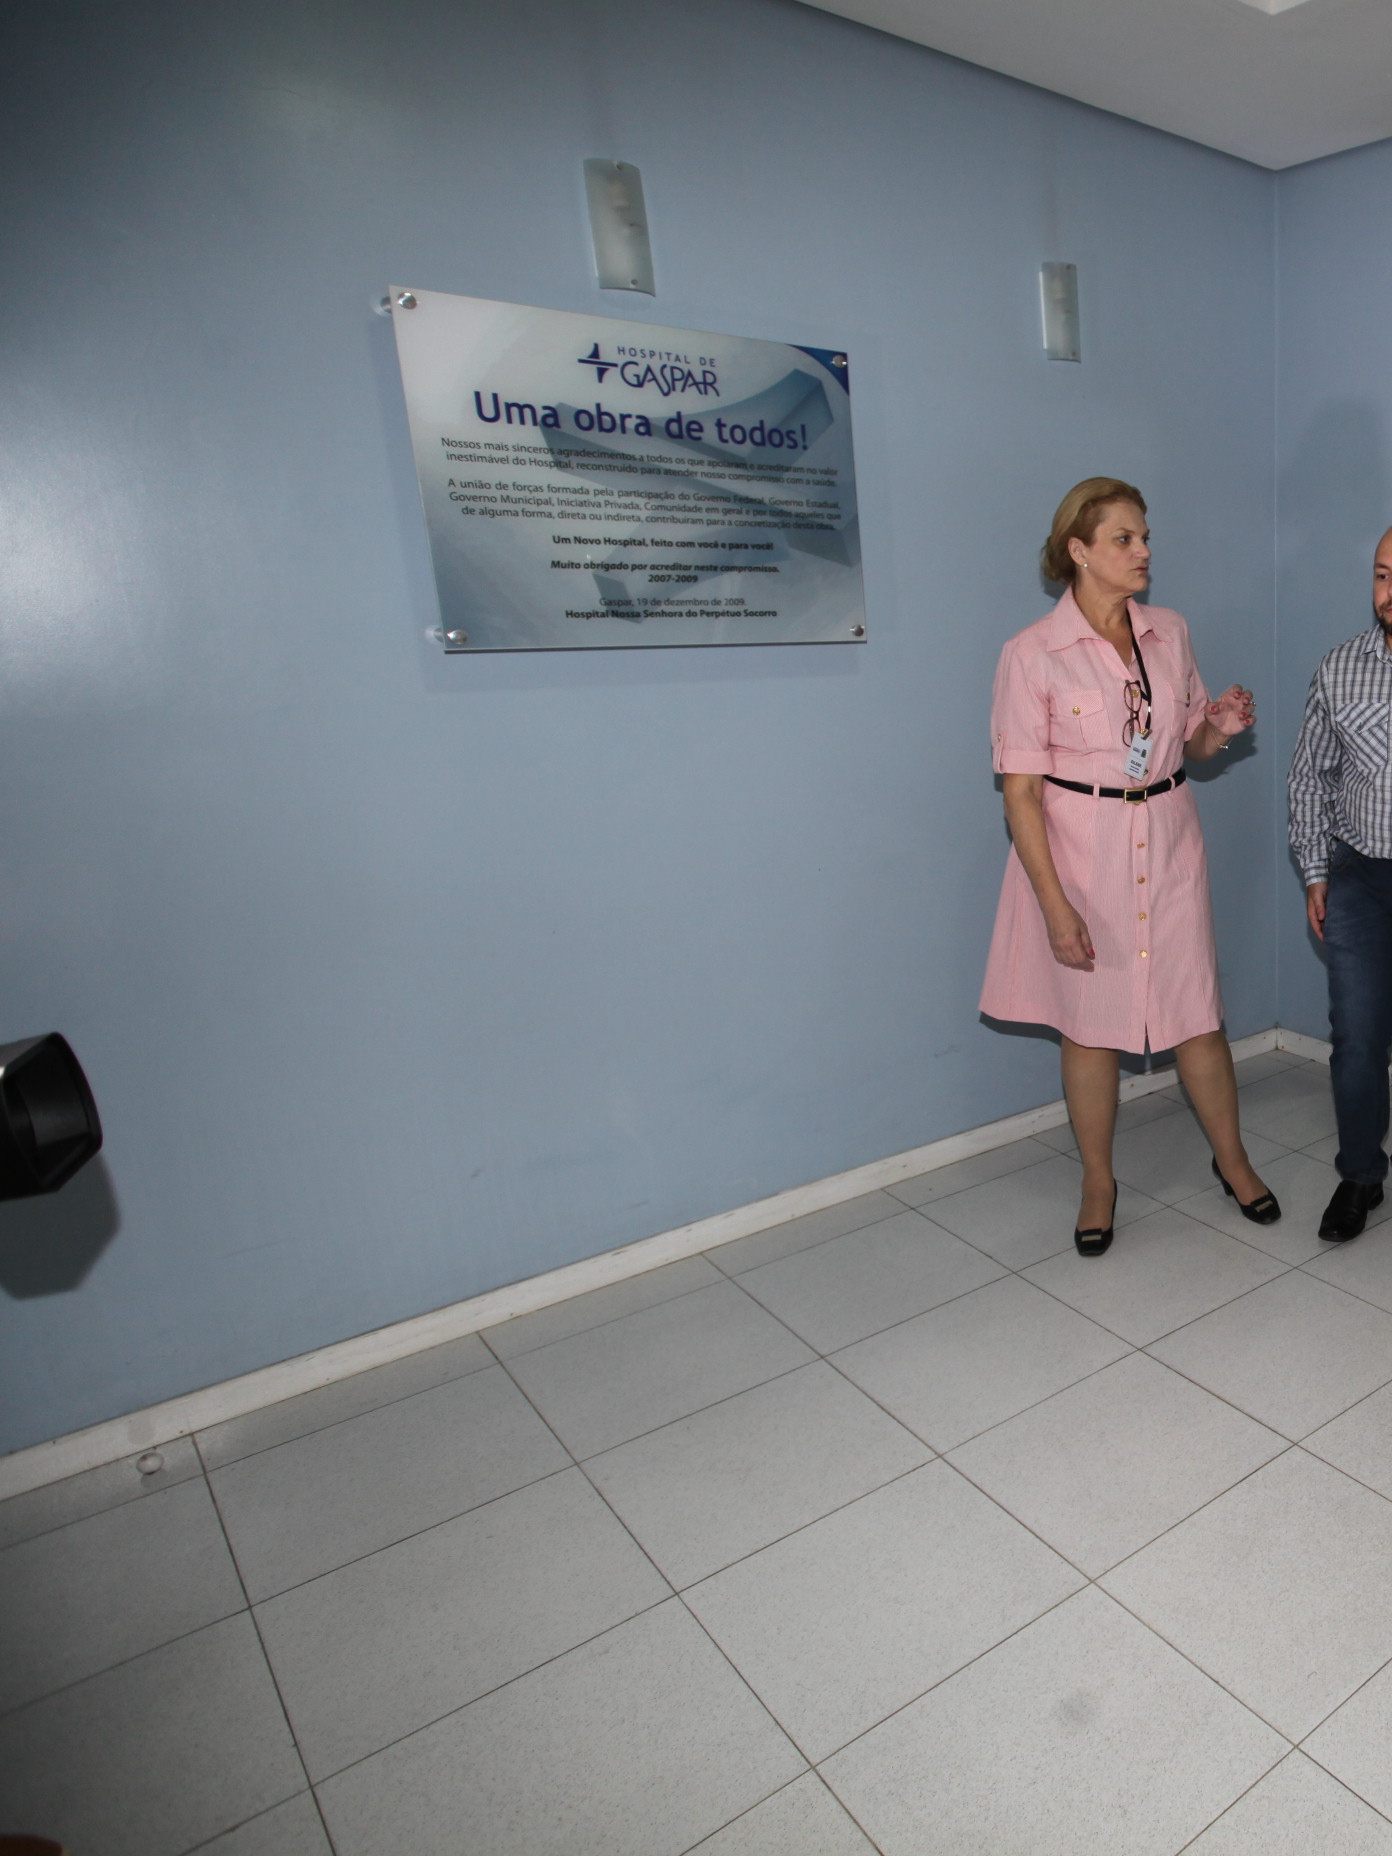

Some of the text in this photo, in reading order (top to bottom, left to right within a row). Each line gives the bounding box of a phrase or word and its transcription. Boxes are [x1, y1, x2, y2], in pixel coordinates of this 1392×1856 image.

[617, 346, 716, 367] HOSPITAL DE
[619, 361, 720, 397] GASPAR
[474, 390, 808, 450] Uma obra de todos!
[441, 438, 481, 449] Nossos
[484, 442, 509, 451] mais
[512, 444, 554, 455] sinceros
[557, 448, 636, 461] agradecimentos
[646, 454, 673, 464] todos
[687, 458, 705, 467] que
[819, 467, 838, 475] valor
[446, 451, 509, 464] inestimável
[512, 456, 526, 466] do
[529, 457, 574, 470] Hospital,
[640, 466, 661, 475] para
[663, 467, 698, 477] atender
[700, 471, 726, 479] nosso
[728, 473, 785, 483] compromisso
[448, 479, 456, 488] A
[460, 480, 492, 490] união
[495, 481, 509, 490] de
[512, 482, 544, 493] forças
[547, 483, 590, 495] formada
[593, 488, 614, 497] pela
[617, 489, 675, 501] participação
[678, 492, 690, 500] do
[693, 493, 731, 503] Governo
[768, 497, 804, 507] Governo
[449, 491, 498, 503] Governo
[500, 495, 554, 507] Municipal,
[557, 498, 602, 509] Iniciativa
[604, 500, 642, 511] Privada,
[644, 502, 703, 514] Comunidade
[721, 507, 743, 516] geral
[753, 509, 767, 517] por
[794, 511, 825, 520] aqueles
[827, 513, 842, 521] que
[461, 506, 476, 516] de
[478, 507, 519, 519] alguma
[521, 508, 555, 519] forma,
[557, 510, 587, 520] direta
[589, 513, 602, 521] ou
[604, 512, 644, 523] indireta,
[706, 518, 725, 527] para
[734, 519, 790, 529] concretização
[552, 536, 571, 545] Um
[573, 536, 601, 546] Novo
[604, 537, 648, 548] Hospital,
[650, 538, 673, 548] feito
[697, 540, 719, 549] você
[729, 542, 749, 551] para
[551, 560, 780, 574] Muito obrigado por acreditar neste compromisso.
[648, 574, 698, 583] 2007-2009
[565, 609, 777, 619] Hospital Nossa Senhora do Perpétuo Socorro
[599, 597, 634, 608] Gaspar,
[637, 598, 648, 606] 19
[650, 598, 662, 607] de
[664, 598, 709, 607] dezembro
[711, 598, 722, 607] de
